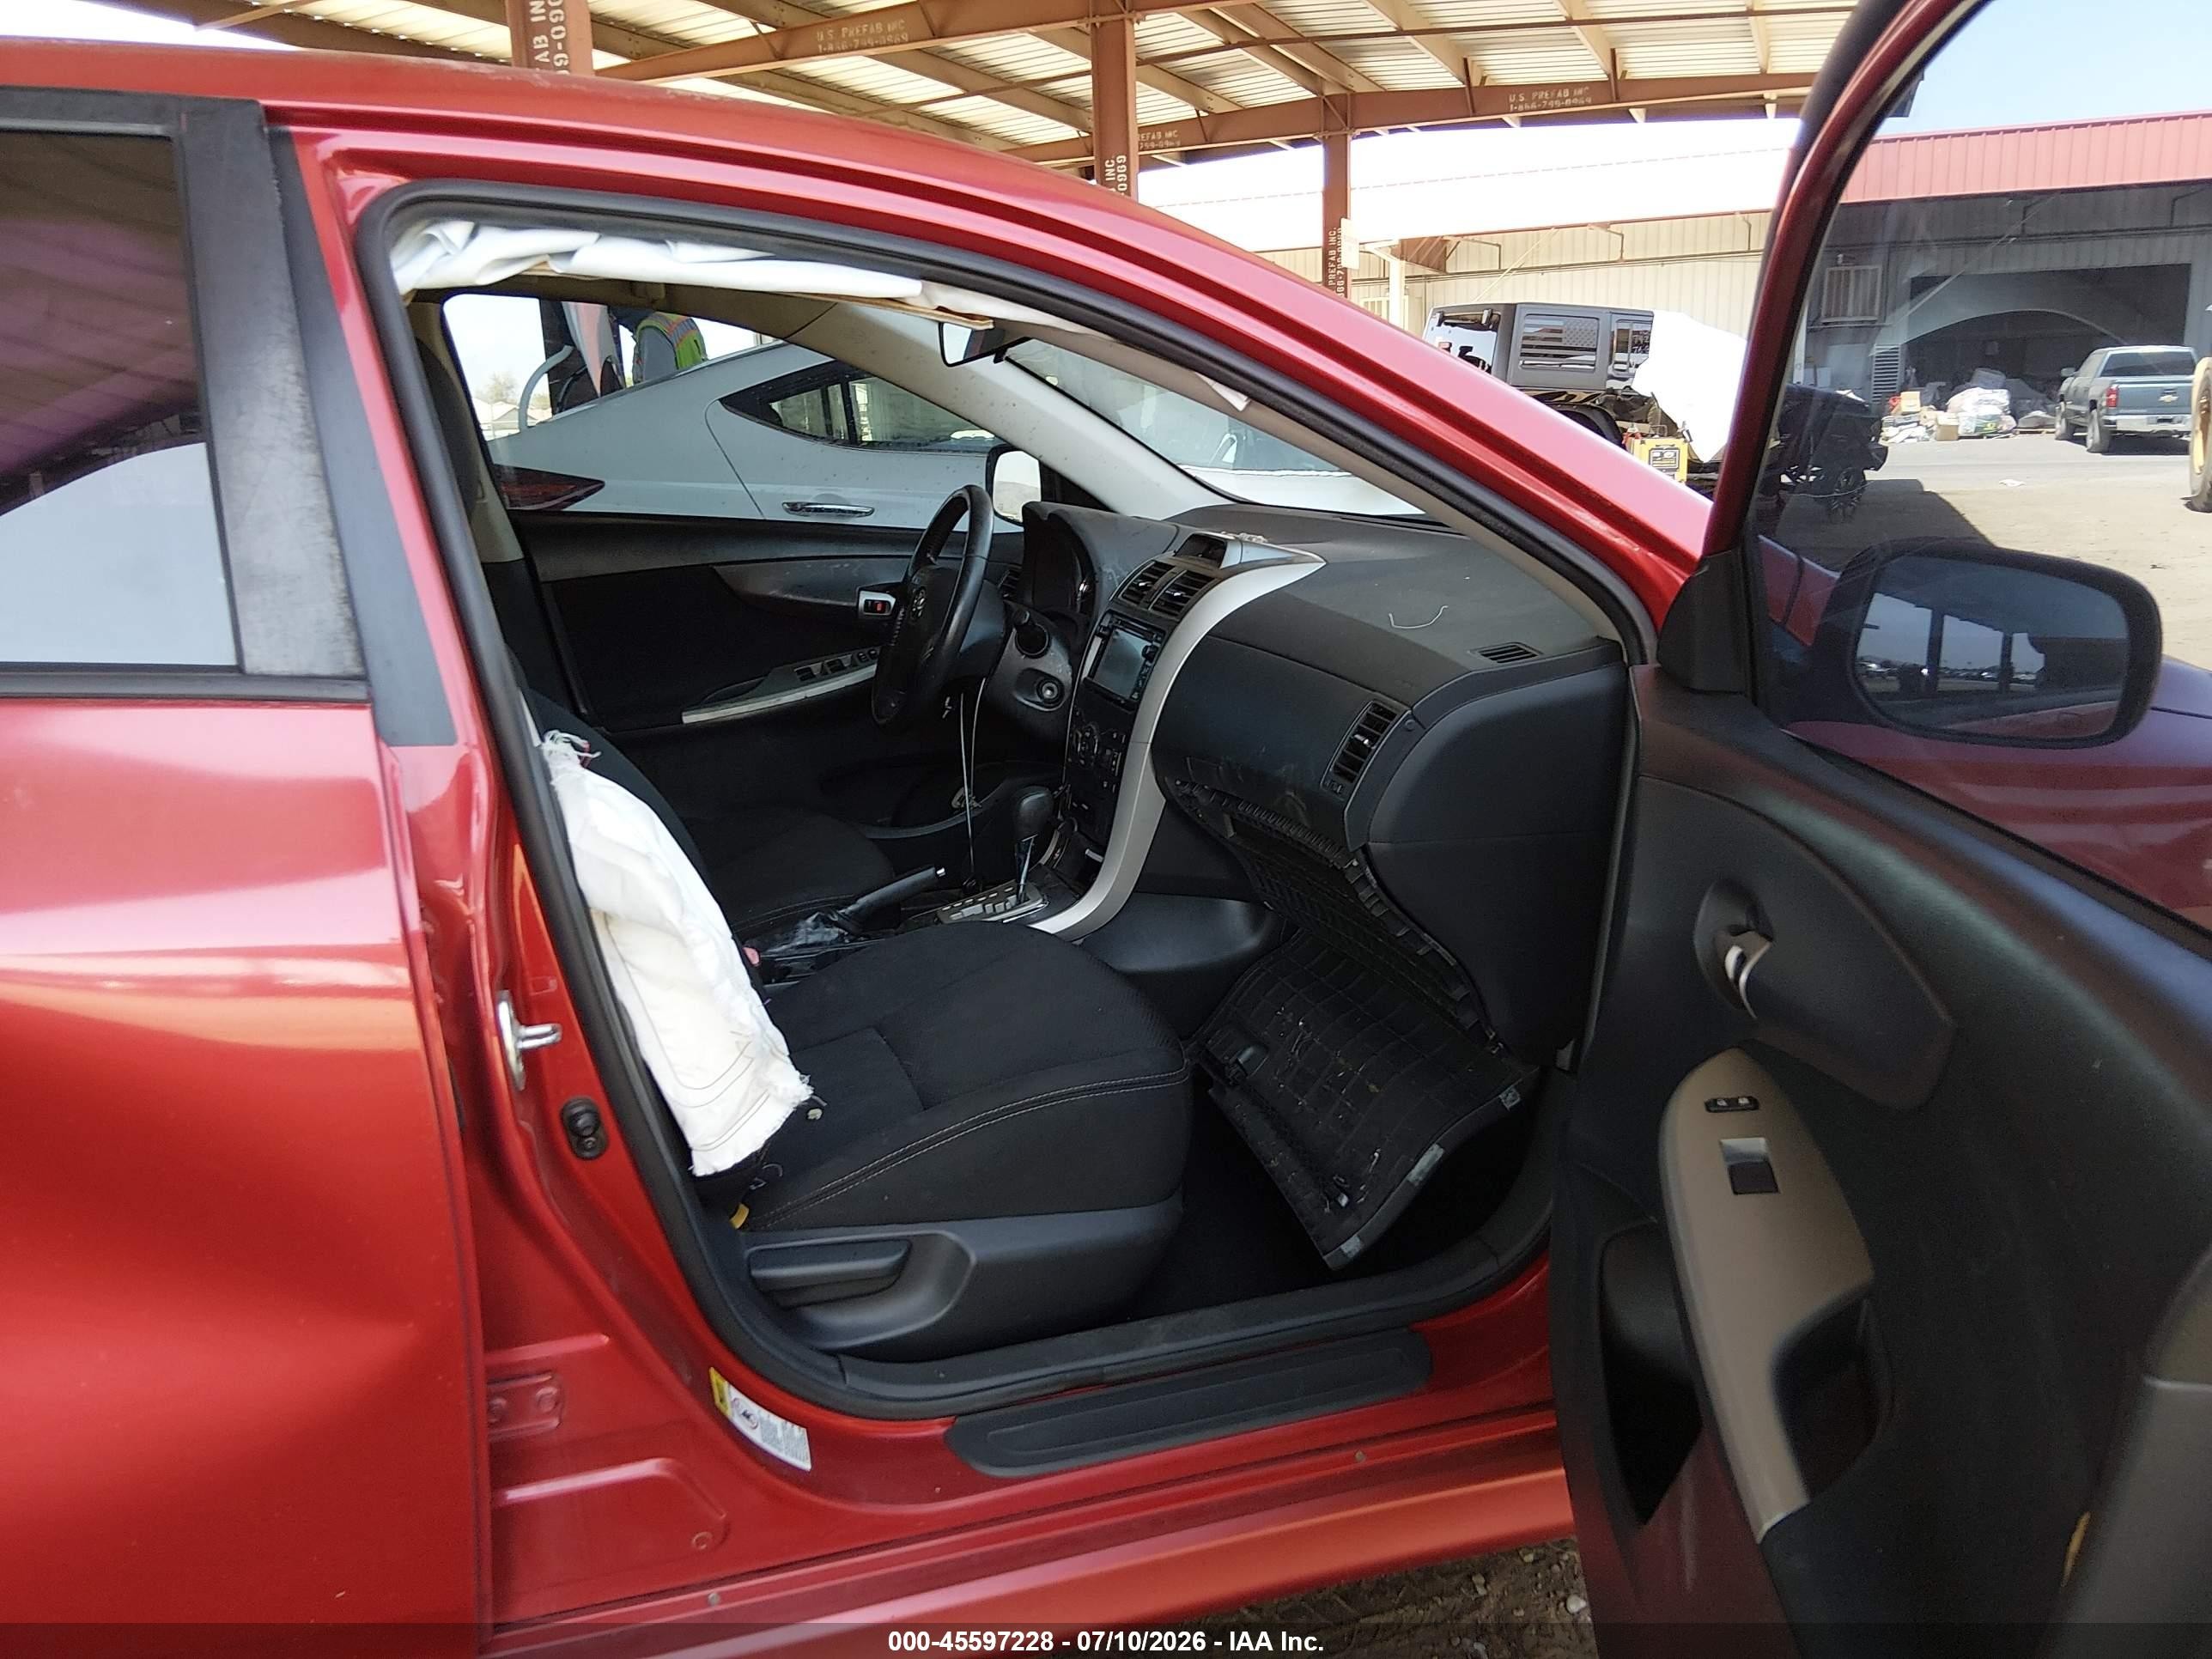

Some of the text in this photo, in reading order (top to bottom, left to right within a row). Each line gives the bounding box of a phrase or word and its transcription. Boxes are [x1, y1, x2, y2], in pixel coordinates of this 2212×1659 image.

[842, 22, 884, 39] PREFAB
[533, 34, 550, 71] AB
[1531, 88, 1571, 101] PREFAB
[1328, 249, 1337, 286] PREFAB
